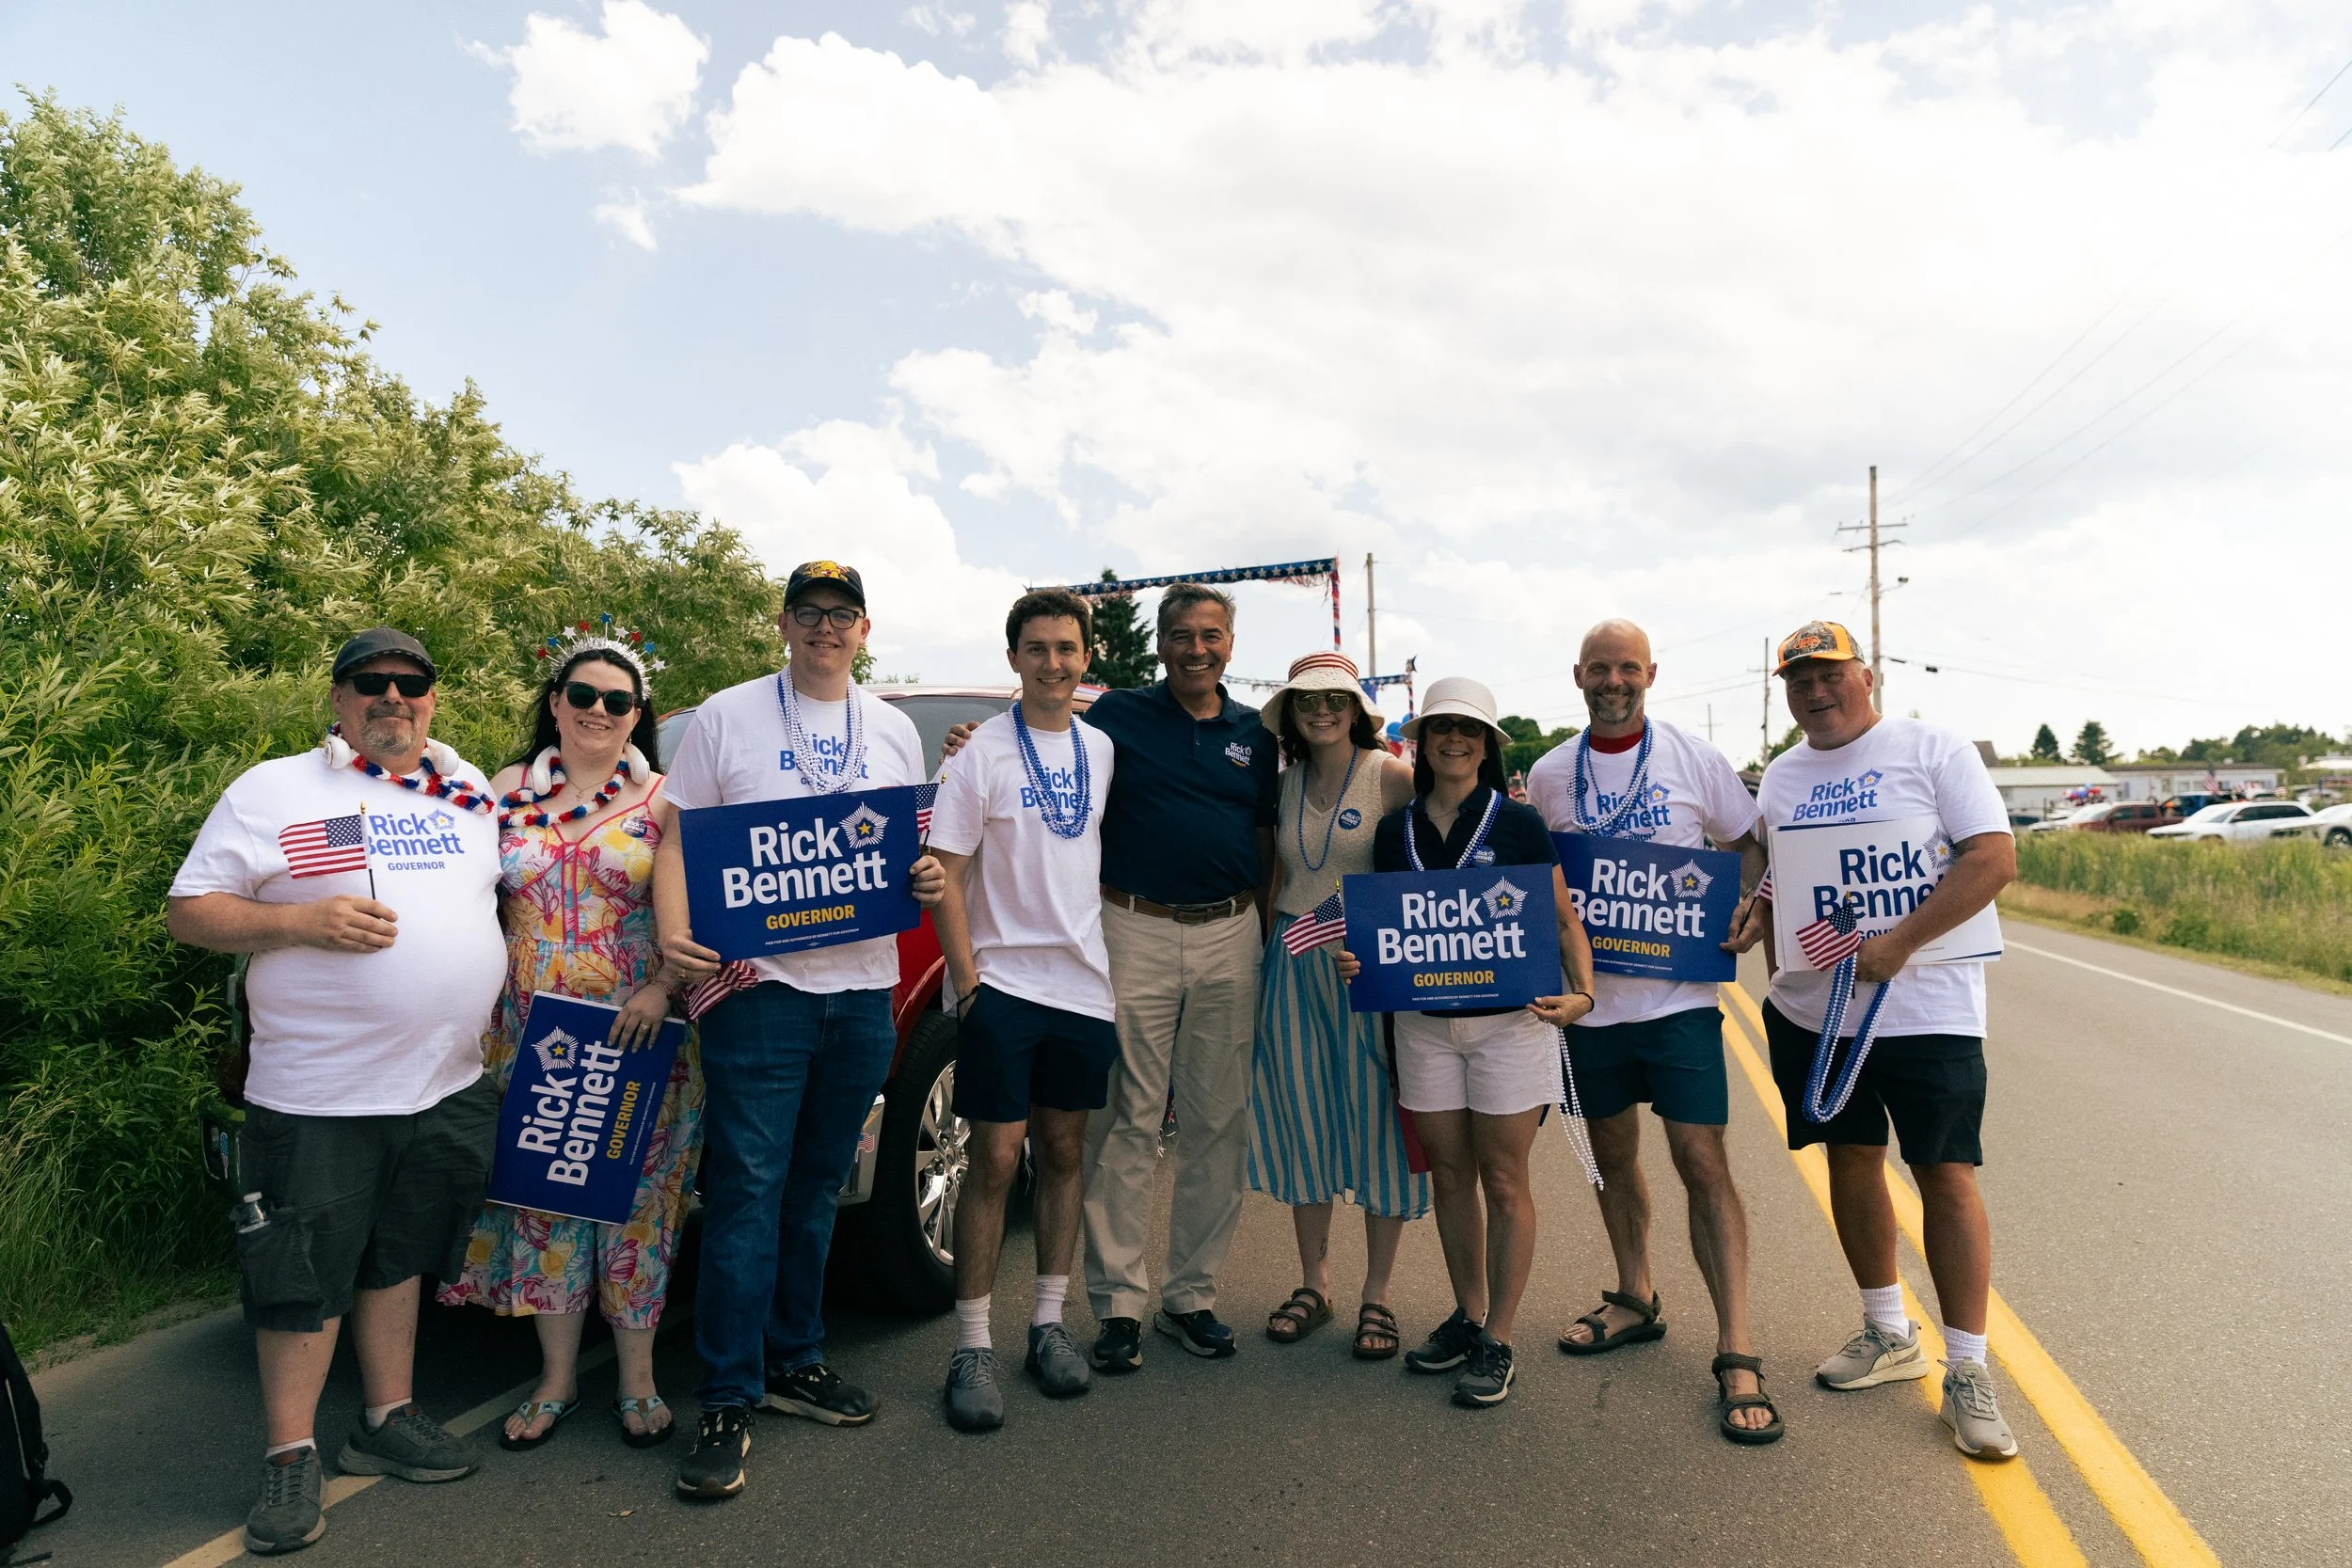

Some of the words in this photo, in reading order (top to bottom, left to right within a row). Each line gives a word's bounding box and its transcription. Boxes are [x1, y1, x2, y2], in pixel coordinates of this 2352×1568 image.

[1225, 747, 1250, 766] Bennett
[1230, 741, 1246, 755] Rick
[1792, 789, 1878, 822] Bennett
[1810, 777, 1856, 803] Rick
[368, 813, 432, 835] Rick
[749, 817, 843, 867] Rick
[388, 861, 446, 871] GOVERNOR
[723, 850, 888, 909] Bennett
[1591, 858, 1669, 902] Rick
[1838, 840, 1927, 886] Rick
[766, 904, 855, 930] GOVERNOR
[1402, 888, 1484, 929] Rick
[1813, 873, 1945, 923] Benne
[1377, 922, 1527, 965] Bennett
[1592, 936, 1670, 958] GOVERNOR
[1413, 970, 1495, 988] GOVERNOR
[516, 1072, 578, 1154] Rick
[546, 1039, 625, 1186] Bennett
[607, 1080, 642, 1160] GOVERNOR
